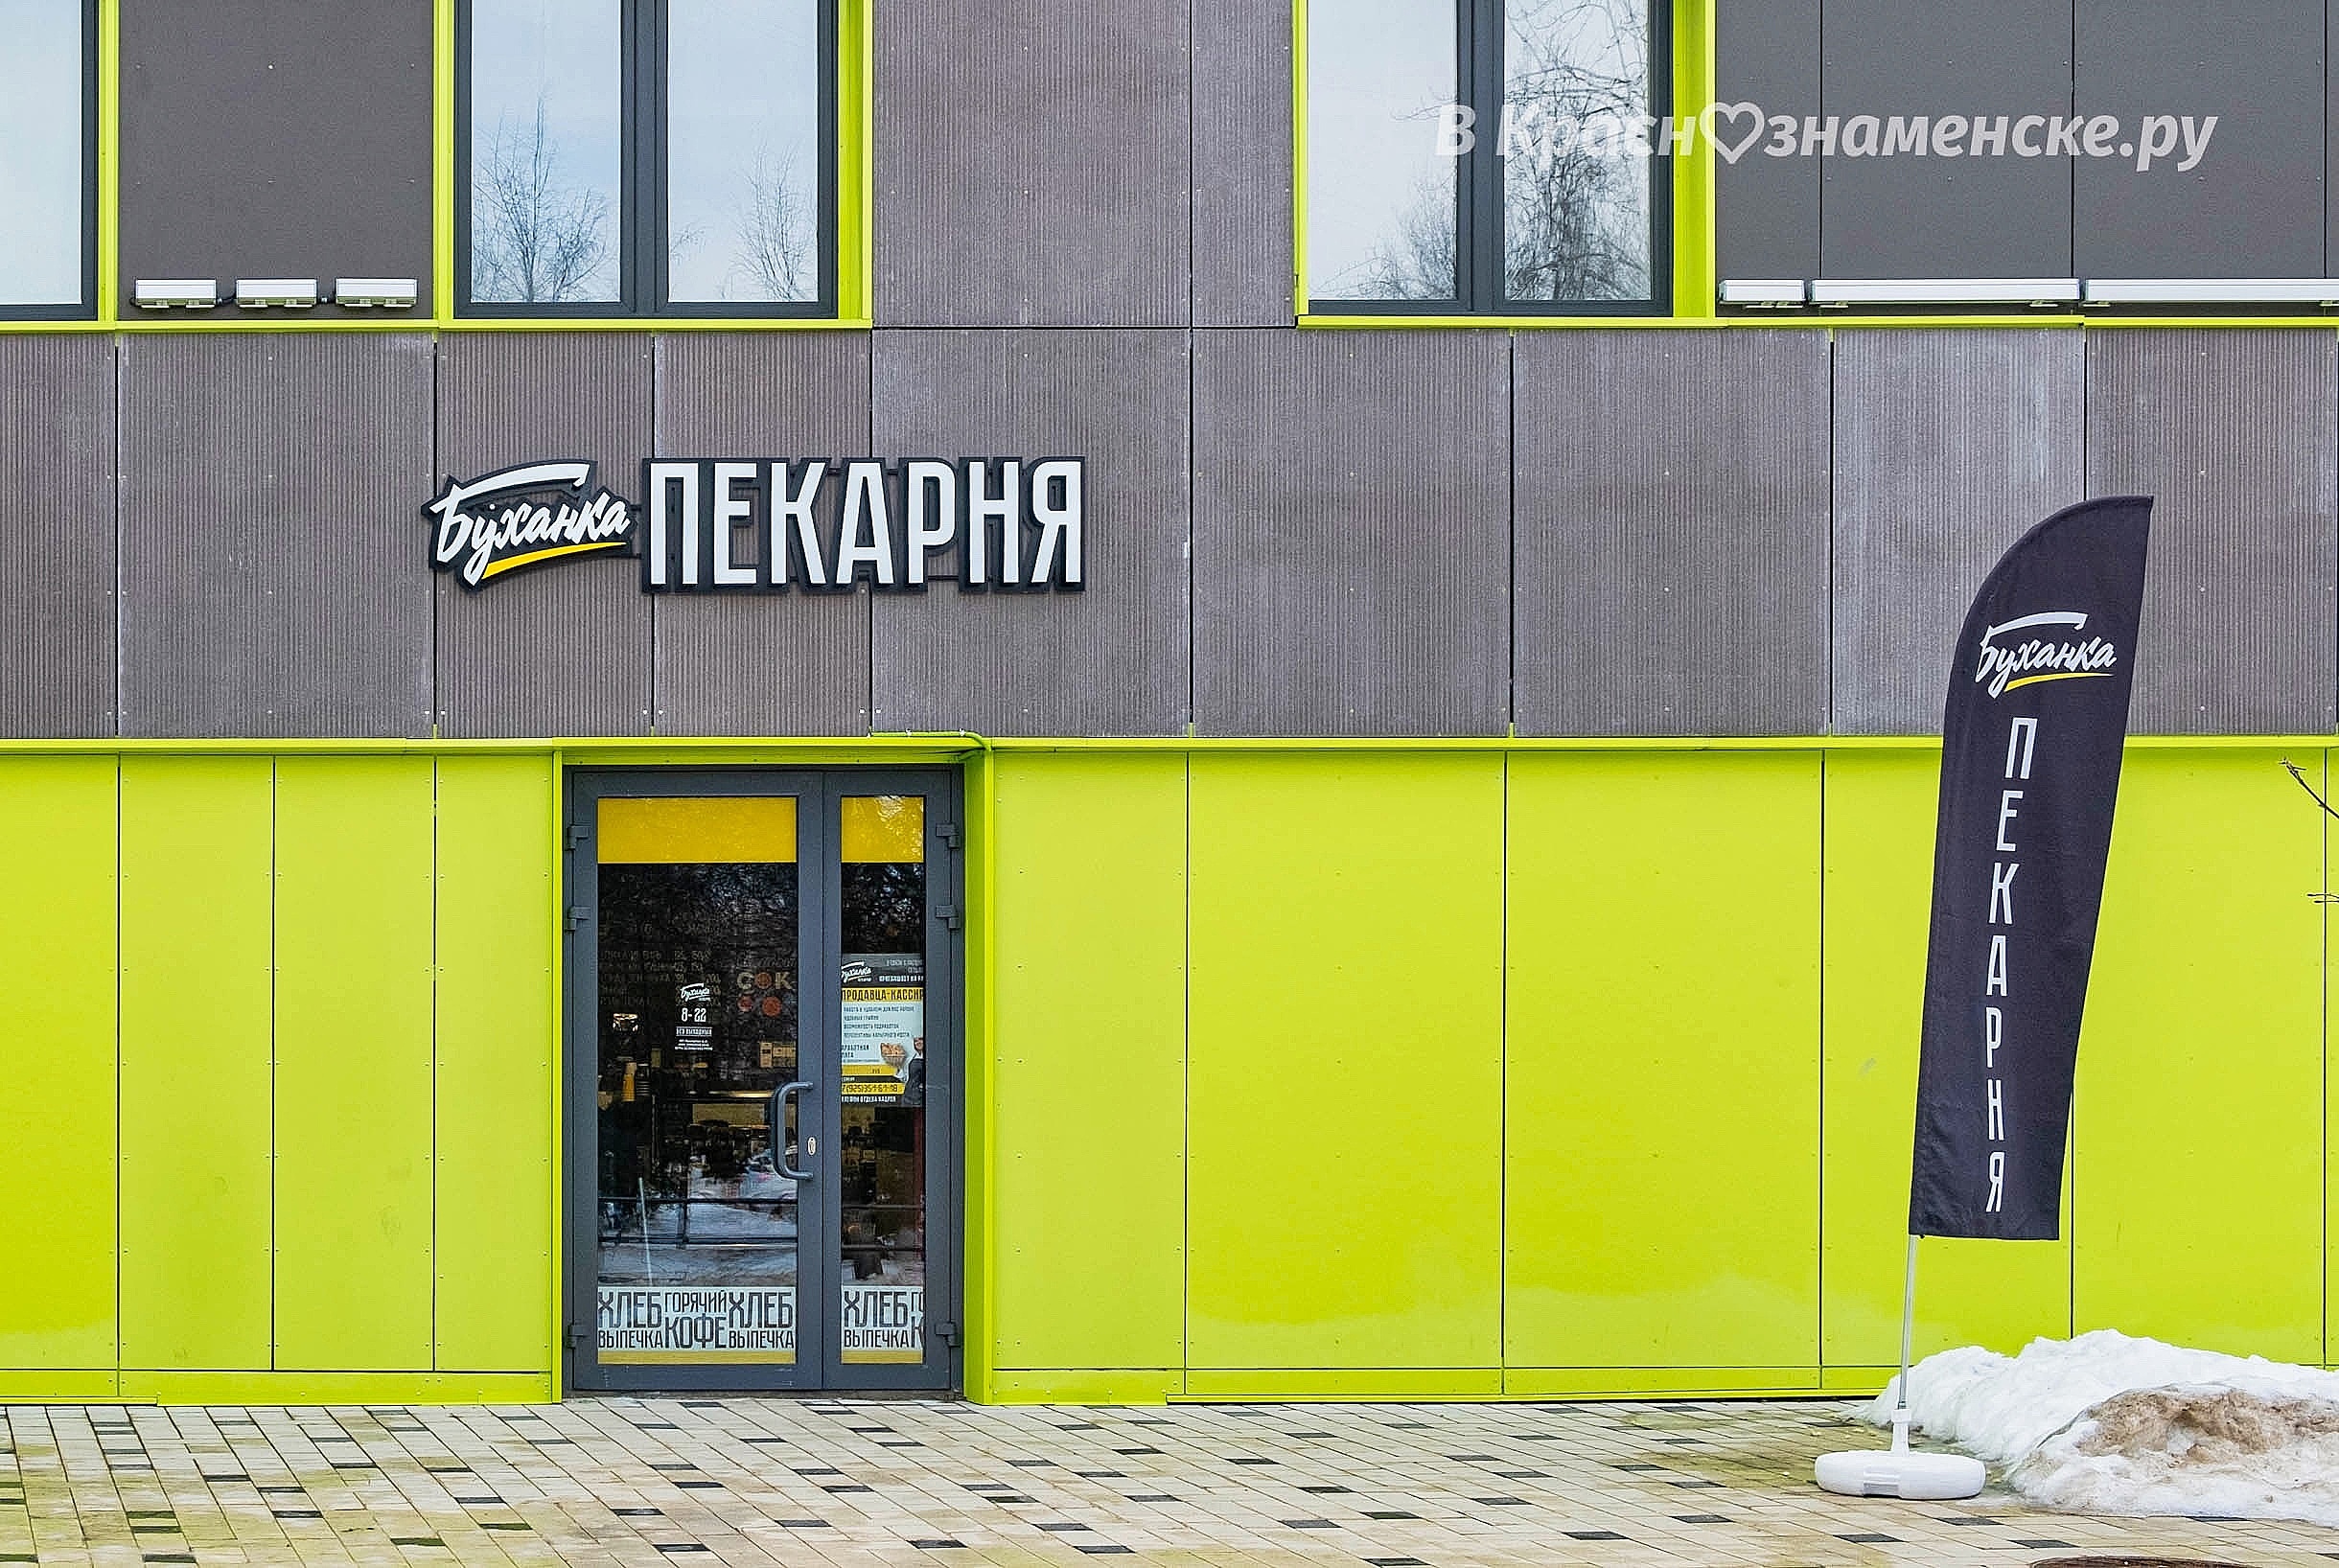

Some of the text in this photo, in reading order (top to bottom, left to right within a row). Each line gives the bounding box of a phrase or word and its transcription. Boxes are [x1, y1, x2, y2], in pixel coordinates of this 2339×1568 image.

[428, 461, 1084, 588] Буханка ПЕКАРНЯ
[1975, 611, 2117, 700] Буханка
[1984, 716, 2038, 1213] ПЕКАРНЯ
[598, 1292, 662, 1328] ХЛЕБ
[665, 1290, 727, 1313] ГОРЯЧИЙ
[729, 1292, 793, 1328] ХЛЕБ
[844, 1291, 908, 1327] ХЛЕБ
[598, 1330, 663, 1349] ВЫПЕЧКА
[665, 1313, 727, 1349] КОФЕ
[729, 1330, 794, 1349] ВЫПЕЧКА
[844, 1329, 909, 1348] ВЫПЕЧКА
